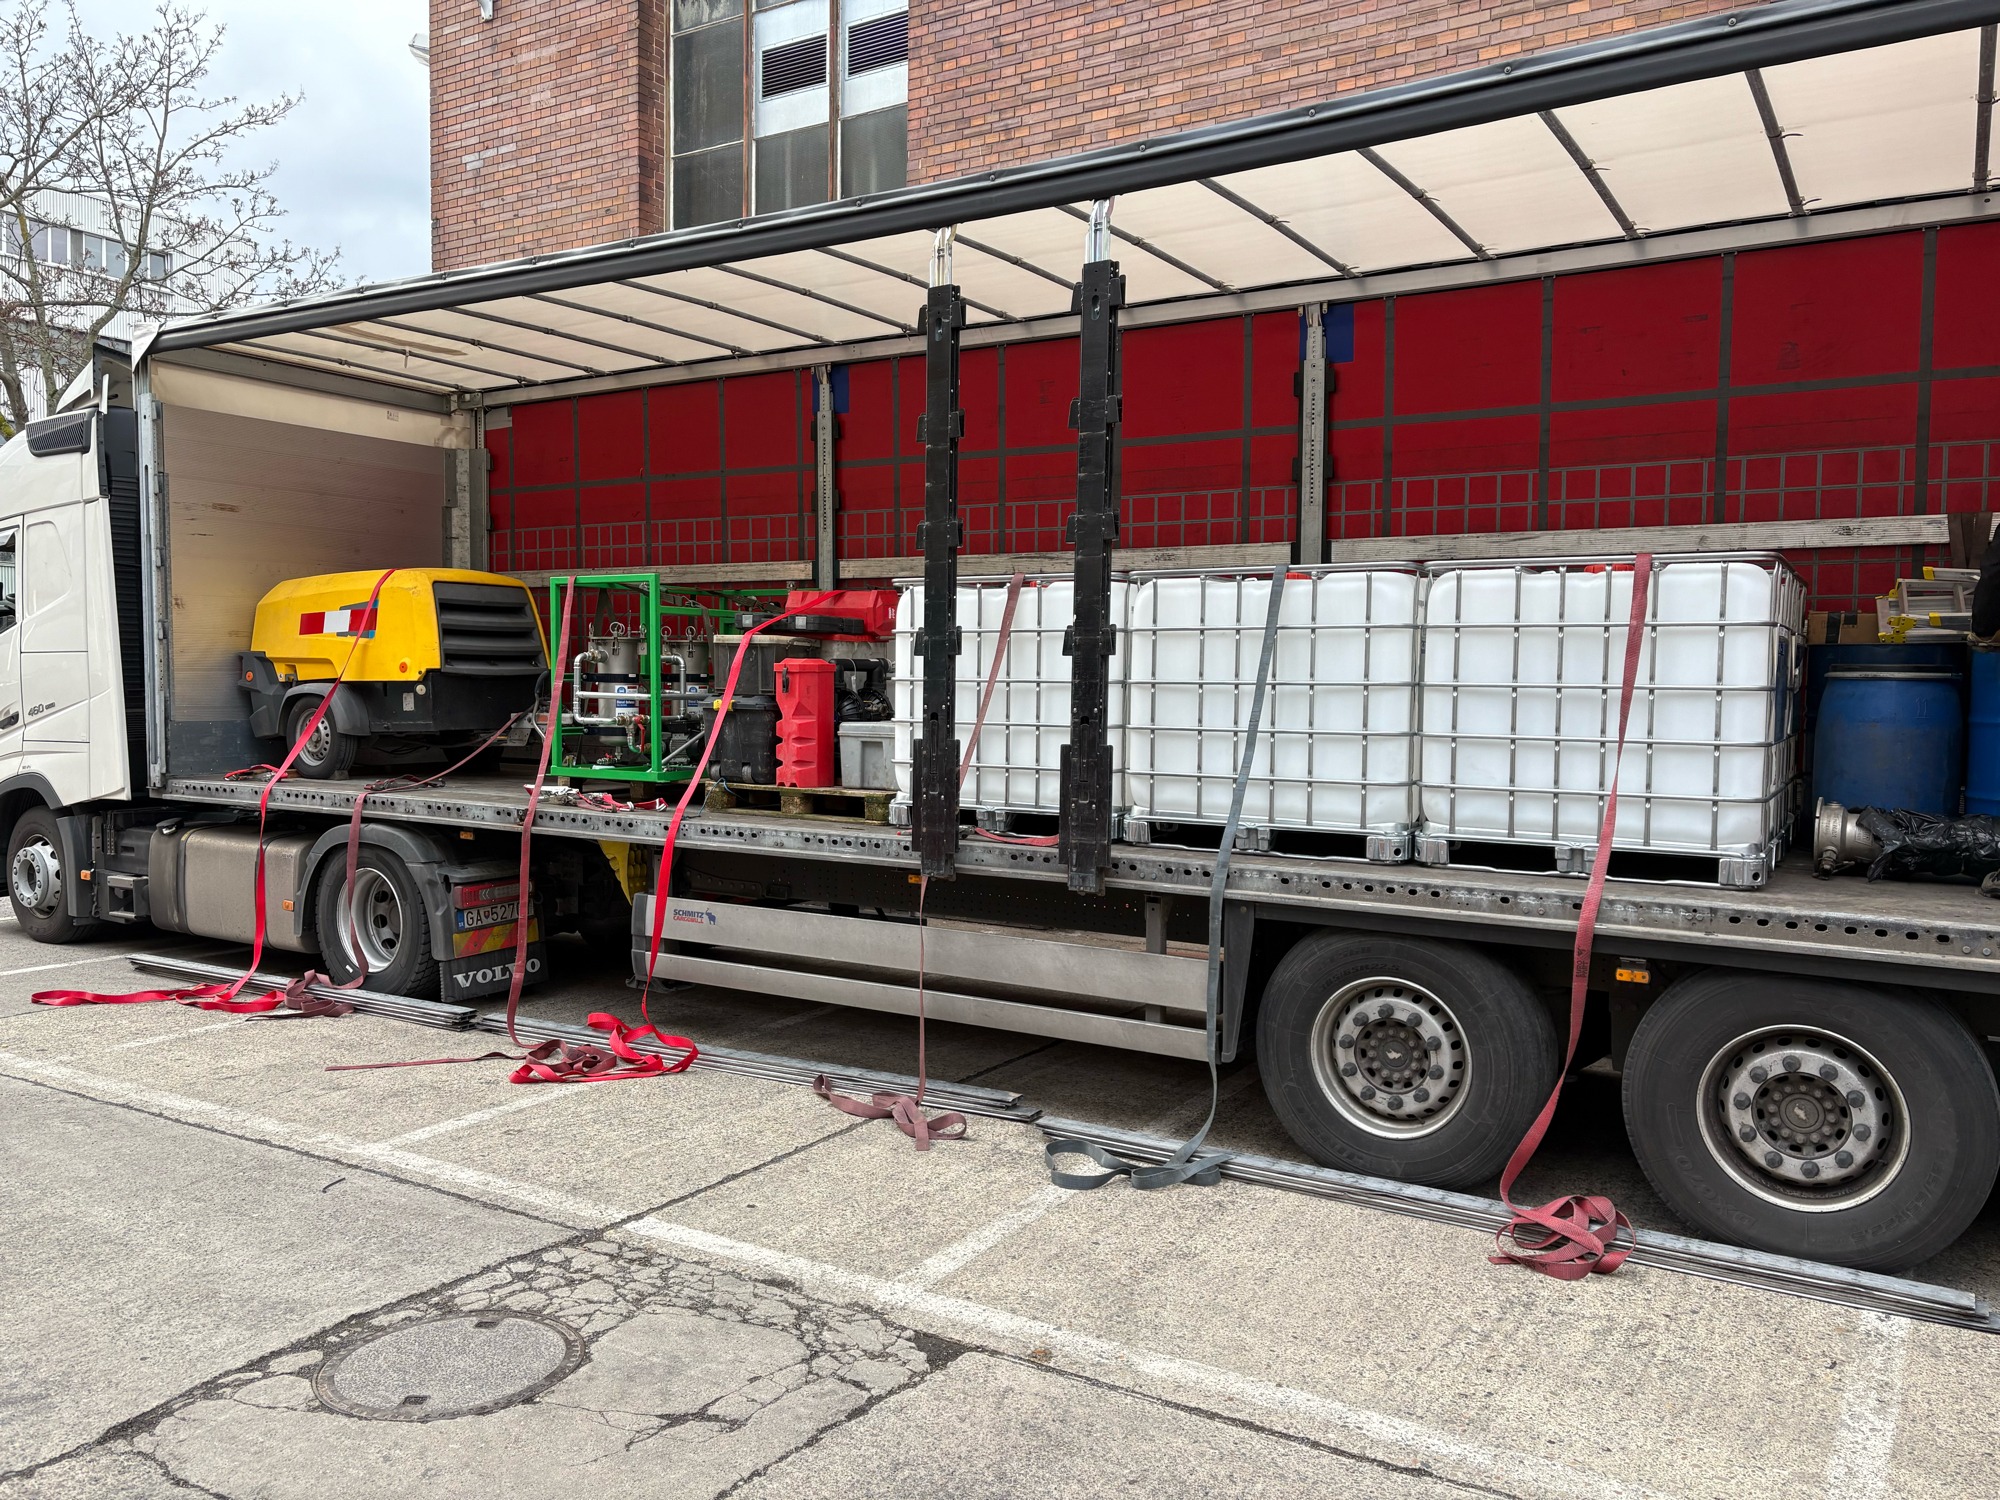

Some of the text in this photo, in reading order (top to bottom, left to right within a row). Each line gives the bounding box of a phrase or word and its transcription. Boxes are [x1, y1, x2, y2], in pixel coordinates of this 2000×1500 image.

[28, 703, 44, 716] 460
[466, 910, 483, 926] GA
[673, 909, 705, 918] SCHMITZ
